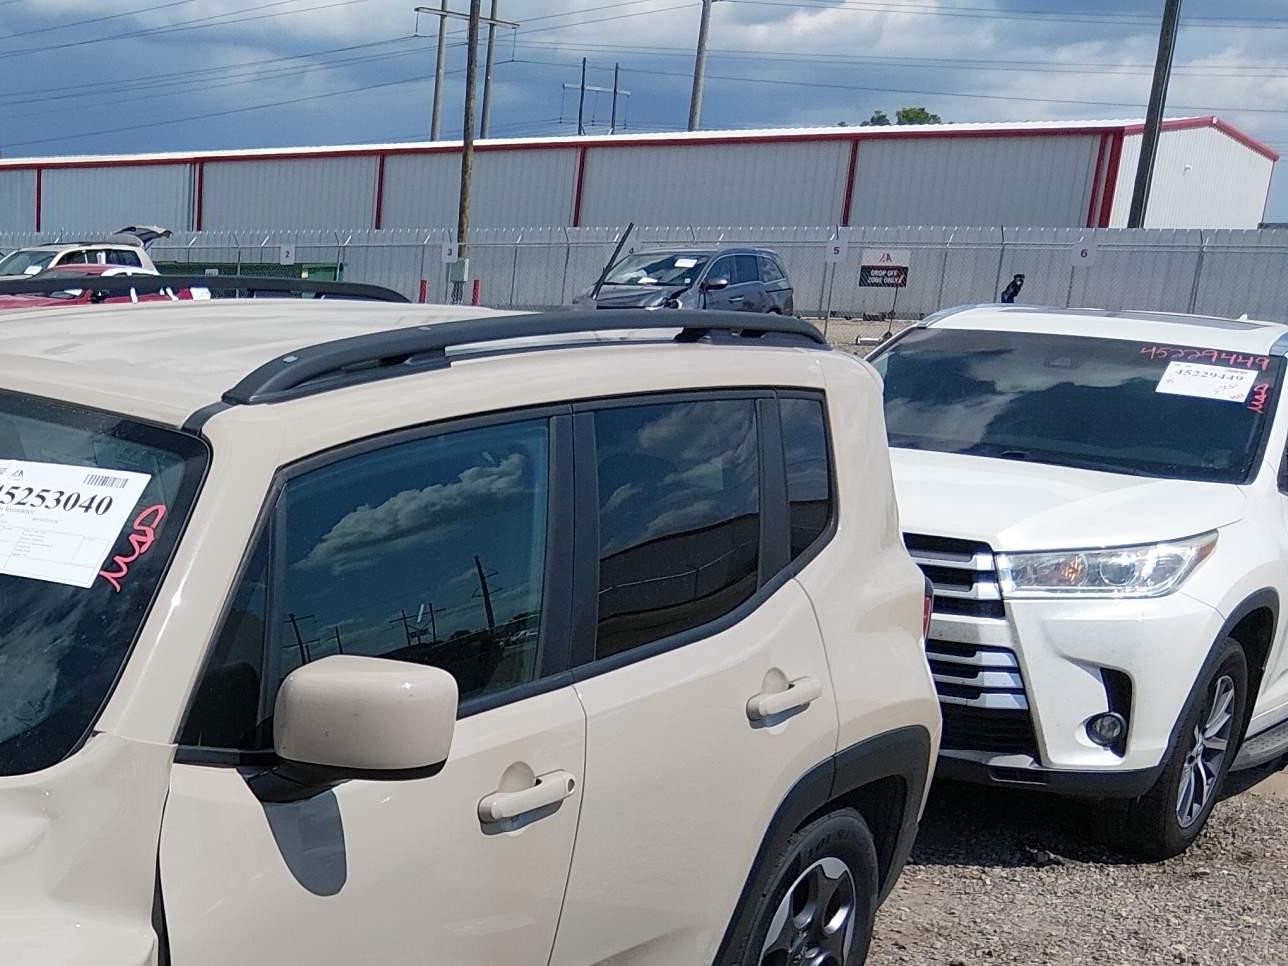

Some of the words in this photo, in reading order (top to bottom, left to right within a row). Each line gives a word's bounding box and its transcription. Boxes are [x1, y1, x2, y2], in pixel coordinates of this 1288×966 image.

[285, 250, 290, 258] 2
[447, 248, 453, 256] 3
[833, 246, 840, 255] 5
[1080, 248, 1088, 258] 6
[1139, 346, 1270, 370] 45229449
[1175, 369, 1244, 382] 45229449
